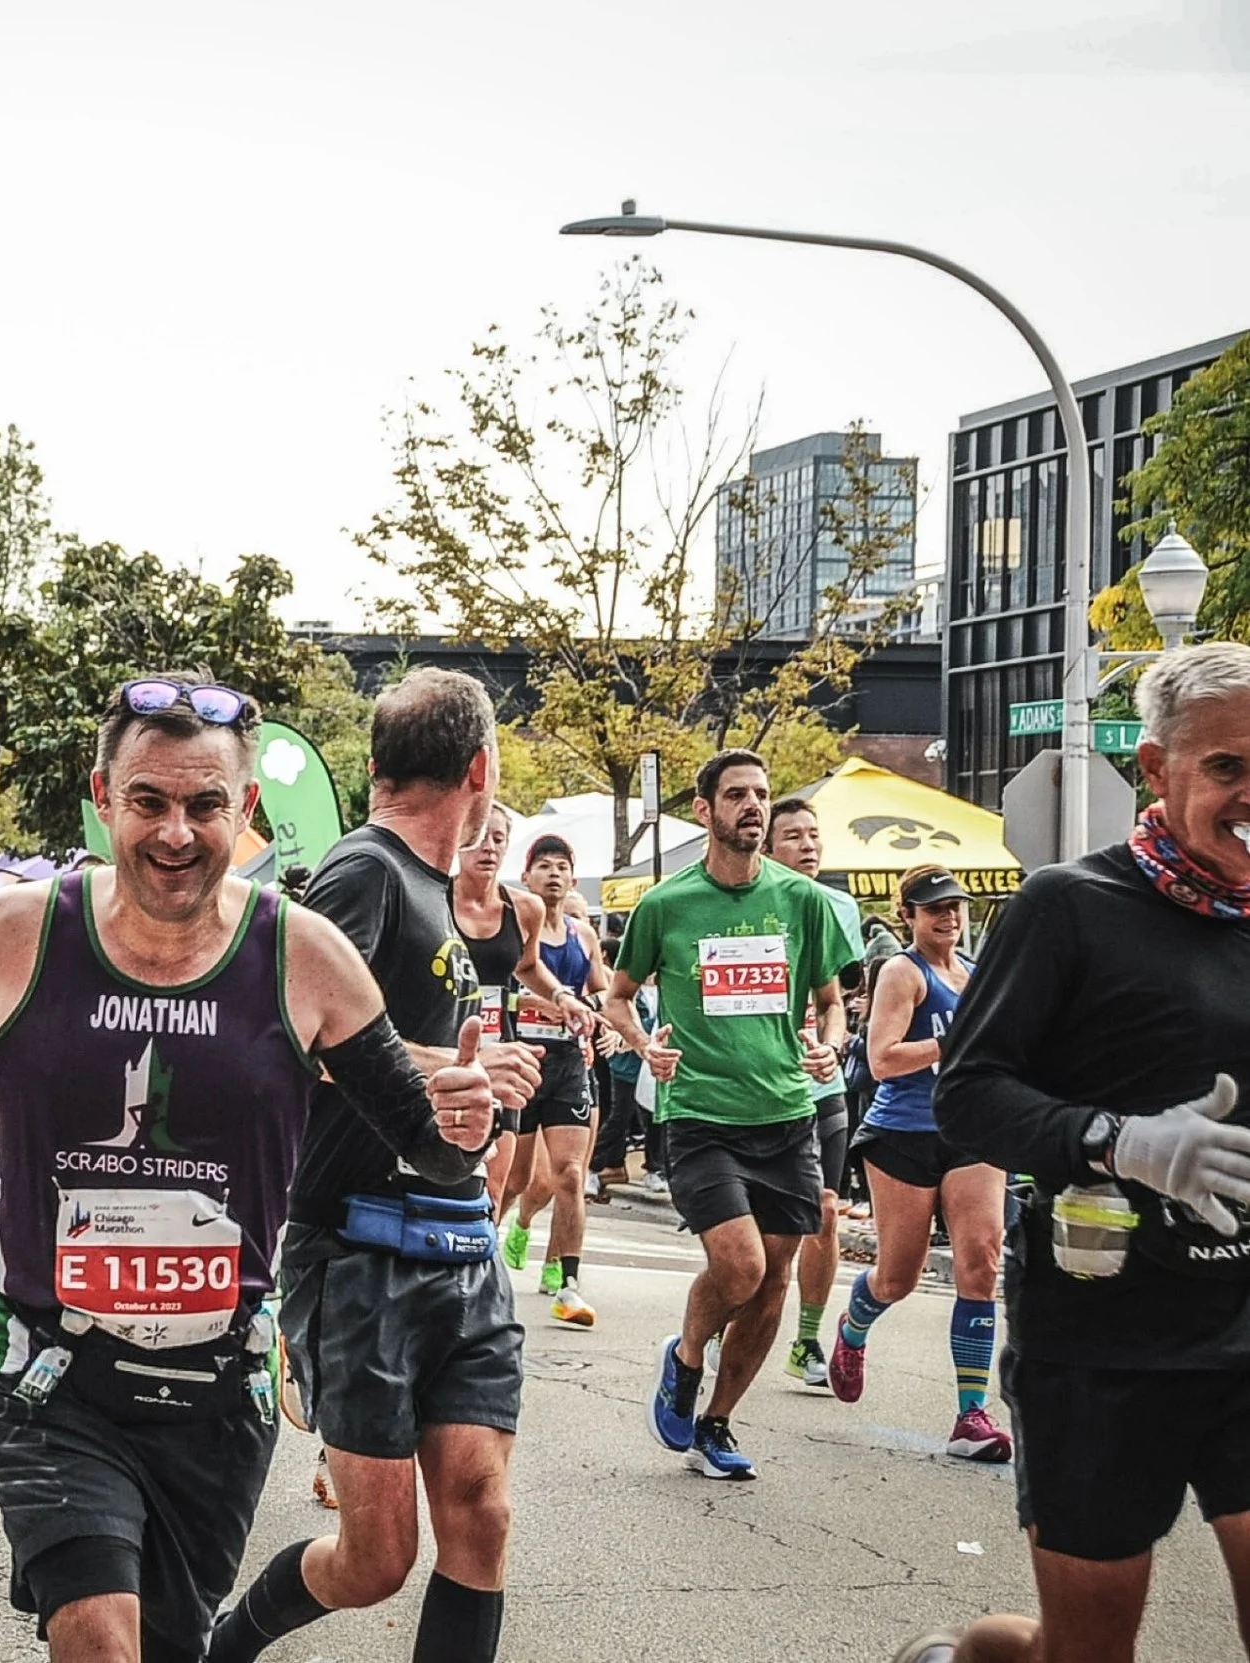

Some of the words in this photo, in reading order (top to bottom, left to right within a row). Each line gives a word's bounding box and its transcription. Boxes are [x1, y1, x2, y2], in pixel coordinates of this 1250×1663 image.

[1020, 705, 1056, 731] ADAMS
[1105, 730, 1114, 744] S
[952, 870, 1022, 892] KEYES
[704, 969, 720, 986] D
[725, 966, 785, 985] 17332
[89, 994, 218, 1036] JONATHAN
[55, 1151, 137, 1174] SCRABO
[142, 1157, 228, 1183] STRIDERS
[94, 1213, 136, 1226] Chicago
[94, 1224, 146, 1234] Marathon
[61, 1255, 88, 1290] E
[103, 1255, 233, 1292] 11530
[113, 1302, 149, 1312] October
[160, 1302, 182, 1311] 2023
